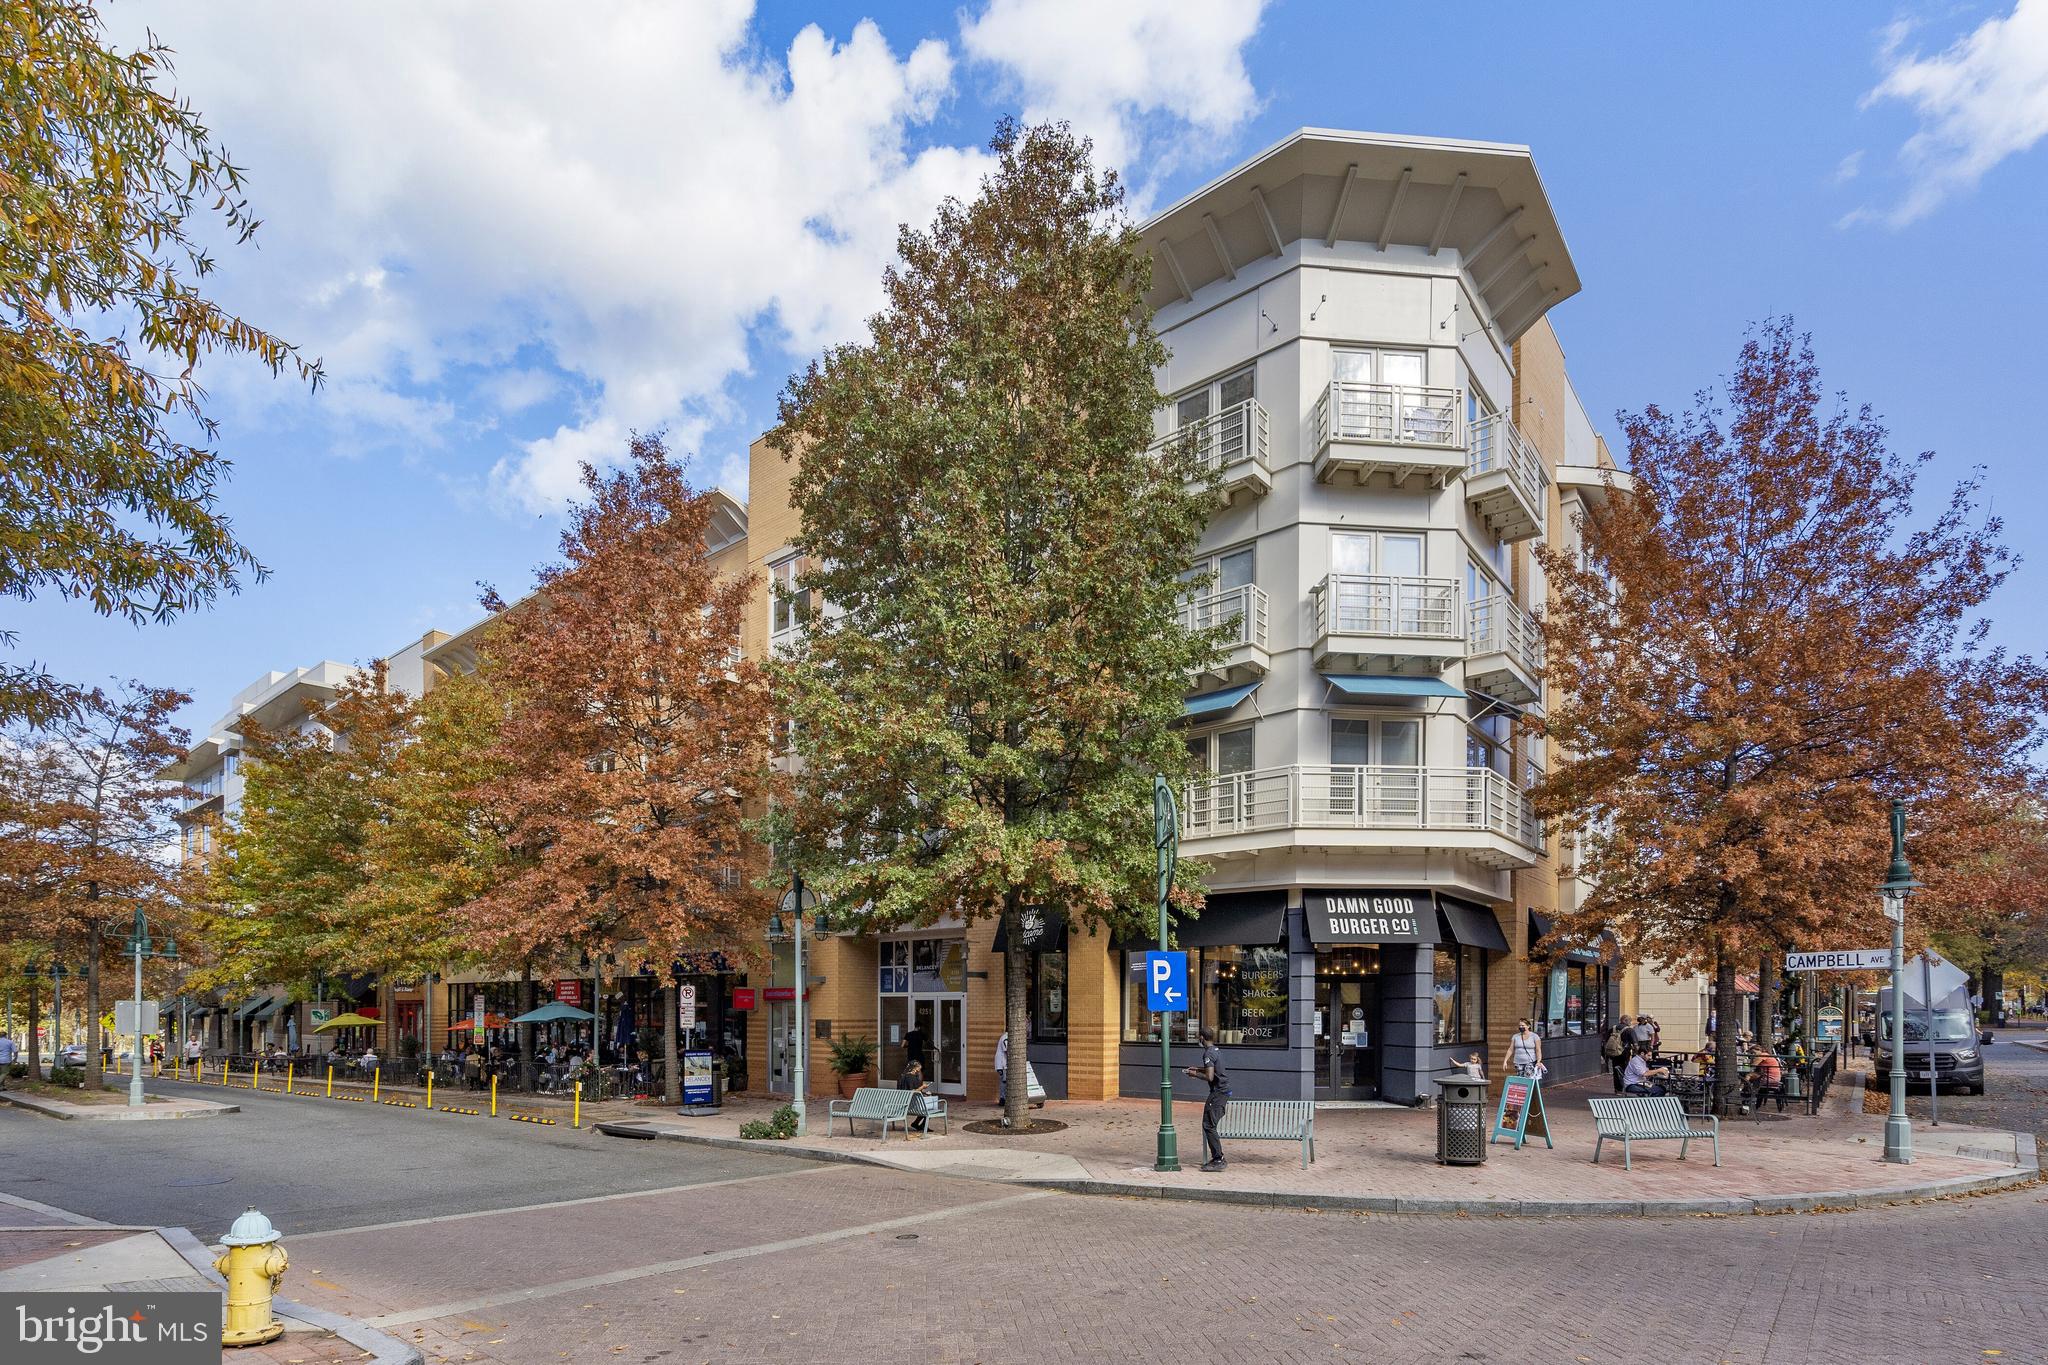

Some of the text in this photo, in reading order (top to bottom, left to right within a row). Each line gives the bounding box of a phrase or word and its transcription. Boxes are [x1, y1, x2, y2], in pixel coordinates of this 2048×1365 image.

[1325, 898, 1414, 914] DAMN GOOD
[1329, 918, 1390, 935] BURGER
[1391, 918, 1410, 932] CO
[1788, 953, 1865, 969] CAMPBELL
[1153, 959, 1171, 994] P
[1241, 969, 1284, 980] BURGERS
[1242, 989, 1276, 998] SHAKES
[1241, 1008, 1265, 1018] BEER
[1242, 1027, 1273, 1038] BOOZE
